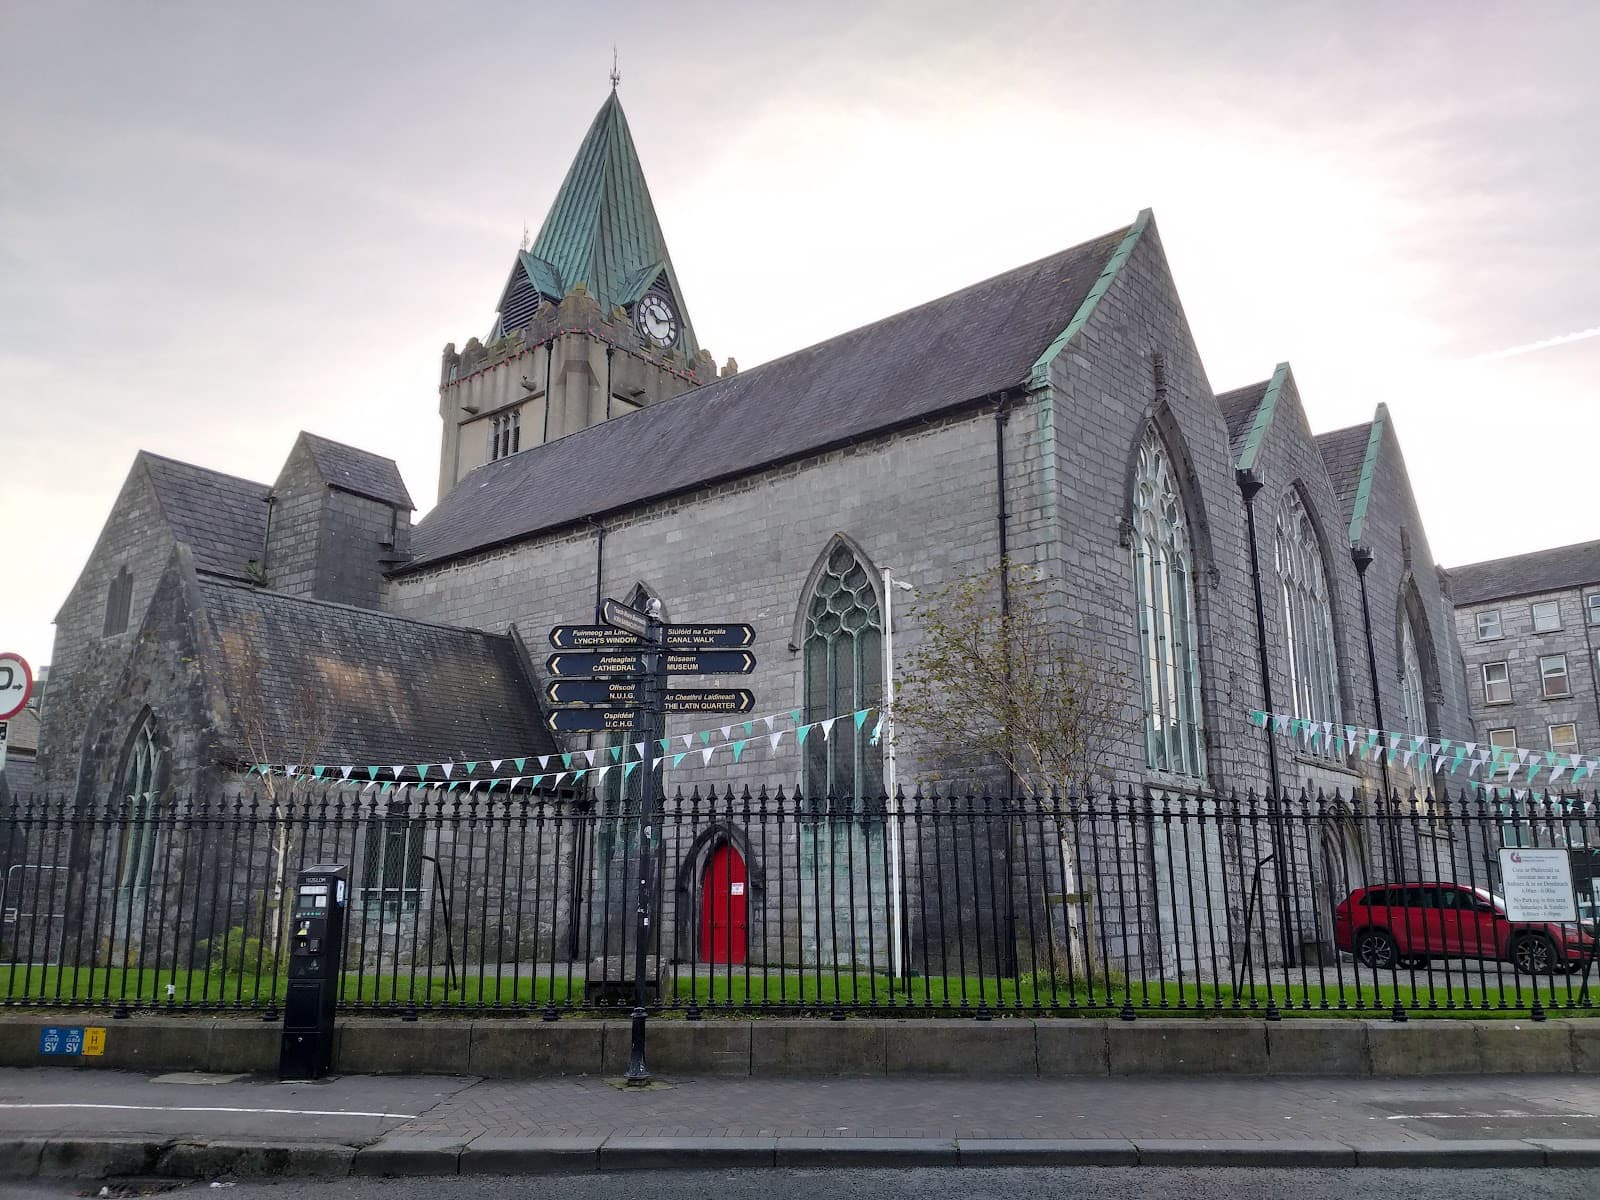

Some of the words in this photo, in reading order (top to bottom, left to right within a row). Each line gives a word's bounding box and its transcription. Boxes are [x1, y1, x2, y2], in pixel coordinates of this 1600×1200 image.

[574, 637, 605, 645] LYNCH'S
[606, 636, 638, 644] WINDOW
[592, 664, 636, 672] CATHEDRAL
[667, 663, 699, 671] MUSEUM
[680, 702, 700, 710] LATIN
[91, 1035, 98, 1045] H
[44, 1042, 58, 1052] SV
[65, 1042, 79, 1053] SV
